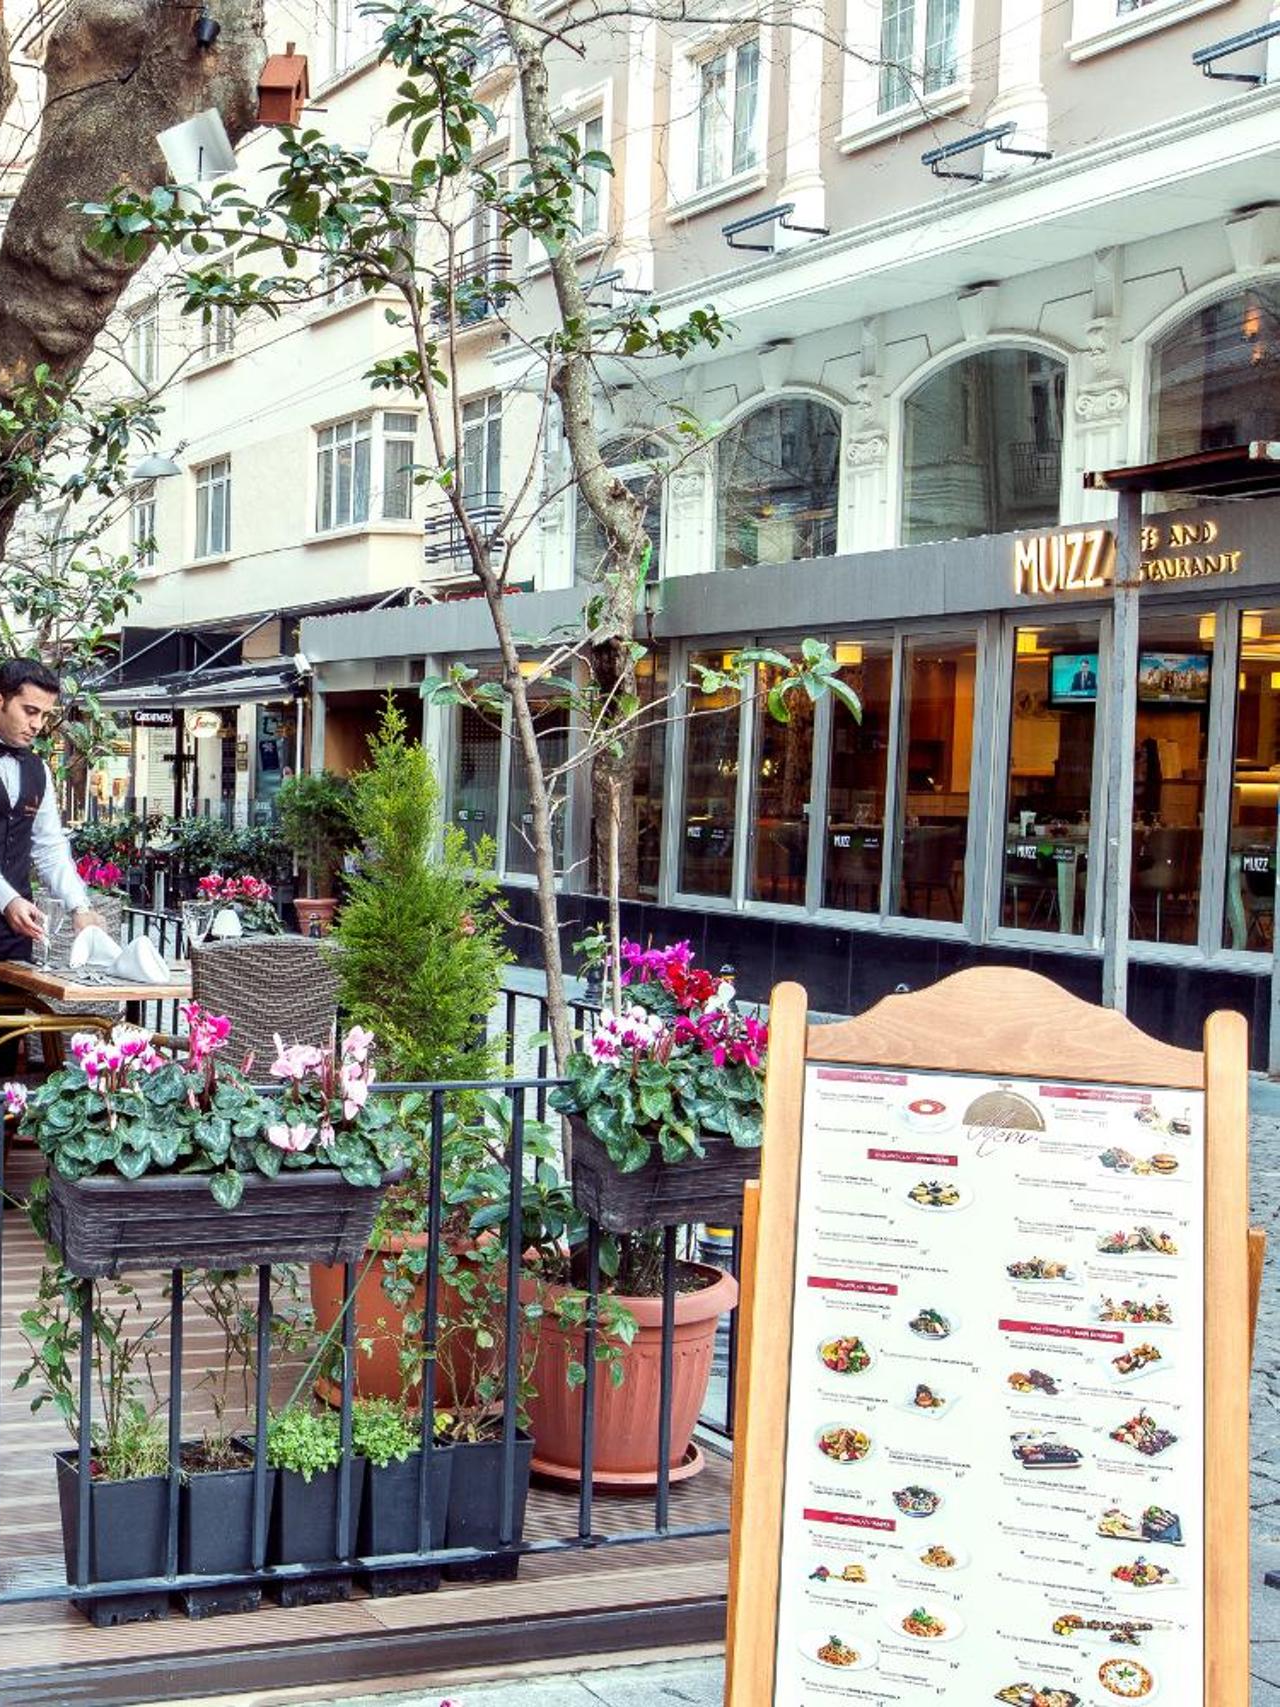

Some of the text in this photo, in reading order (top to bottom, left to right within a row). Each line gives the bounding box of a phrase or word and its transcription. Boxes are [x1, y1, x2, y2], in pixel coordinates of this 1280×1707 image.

[1169, 520, 1217, 547] AND
[1015, 530, 1104, 594] MUIZZ
[1139, 550, 1241, 580] TAURANT
